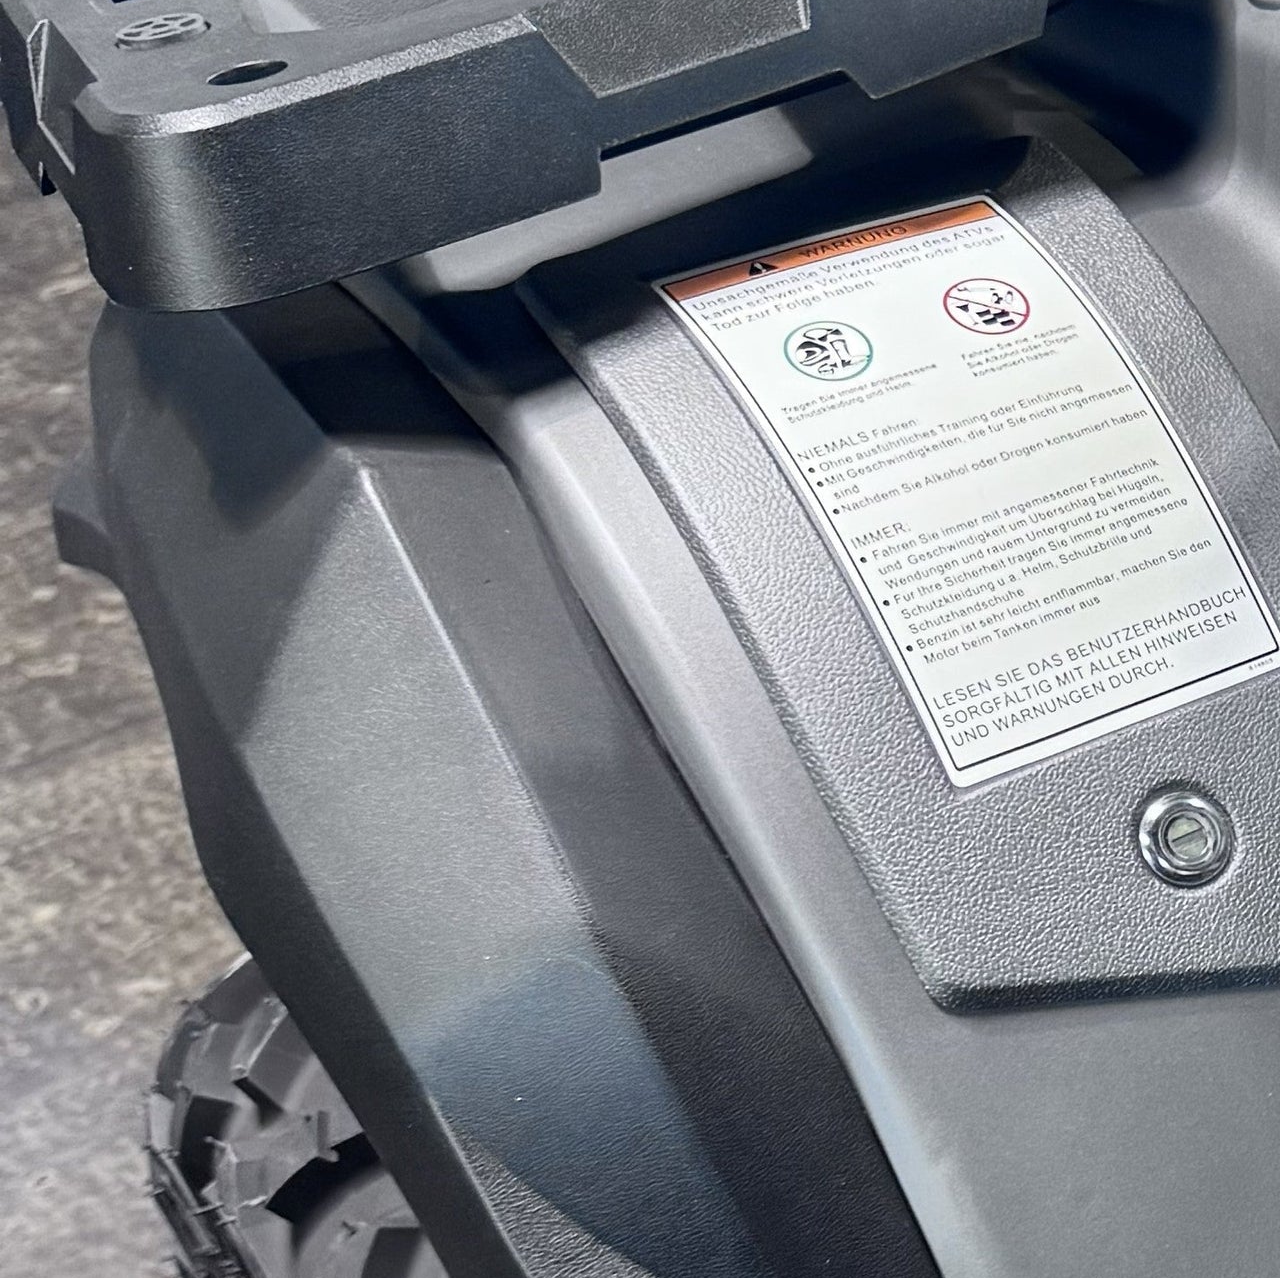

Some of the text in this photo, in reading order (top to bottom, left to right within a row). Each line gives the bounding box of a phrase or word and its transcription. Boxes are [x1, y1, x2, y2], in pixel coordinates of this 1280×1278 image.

[798, 224, 909, 260] WARNUNG
[795, 430, 871, 462] NIEMALS
[817, 454, 854, 473] Ohne
[936, 412, 990, 434] Training
[988, 402, 1017, 419] oder
[823, 471, 847, 486] Mit
[845, 435, 967, 480] Geschwindigkeiten,
[966, 427, 987, 441] die
[1005, 415, 1029, 429] Sie
[1027, 403, 1059, 422] nicht
[1058, 382, 1134, 413] angemessen
[839, 408, 1149, 513] Nachdem Sie Alkohol oder Drogen konsumiert haben
[832, 482, 861, 501] sind
[849, 521, 912, 551] IMMER:
[870, 457, 1160, 561] Fahren Sie immer mit angemessener Fahrtechnik
[876, 558, 904, 576] und
[905, 523, 1008, 566] Geschwindigkeit
[1007, 518, 1029, 533] um
[1095, 485, 1118, 502] bei
[882, 486, 1172, 590] Wendungen und rauem Untergrund zu vermeiden
[899, 580, 997, 621] Schutzkleidung
[1019, 559, 1060, 578] Helm,
[1057, 533, 1129, 566] Schutzbrille
[1128, 523, 1153, 541] und
[914, 627, 961, 651] Benzin
[959, 620, 978, 635] ist
[978, 610, 1006, 629] sehr
[1005, 597, 1042, 618] leicht
[1119, 554, 1168, 578] machen
[1166, 547, 1189, 561] Sie
[1188, 538, 1213, 554] den
[915, 581, 944, 598] Ihre
[942, 557, 1007, 588] Sicherheit
[1005, 545, 1048, 566] tragen
[1046, 537, 1069, 552] Sie
[1067, 523, 1107, 545] immer
[1107, 497, 1189, 532] angemessene
[906, 587, 1026, 635] Schutzhandschuhe
[921, 595, 1102, 665] Motor beim Tanken immer aus
[931, 584, 1247, 711] LESEN SIE DAS BENUTZERHANDBUCH
[941, 609, 1239, 729] SORGFÄLTIG MIT ALLEN HINWEISEN
[949, 655, 1175, 748] UND WARNUNGEN DURCH.
